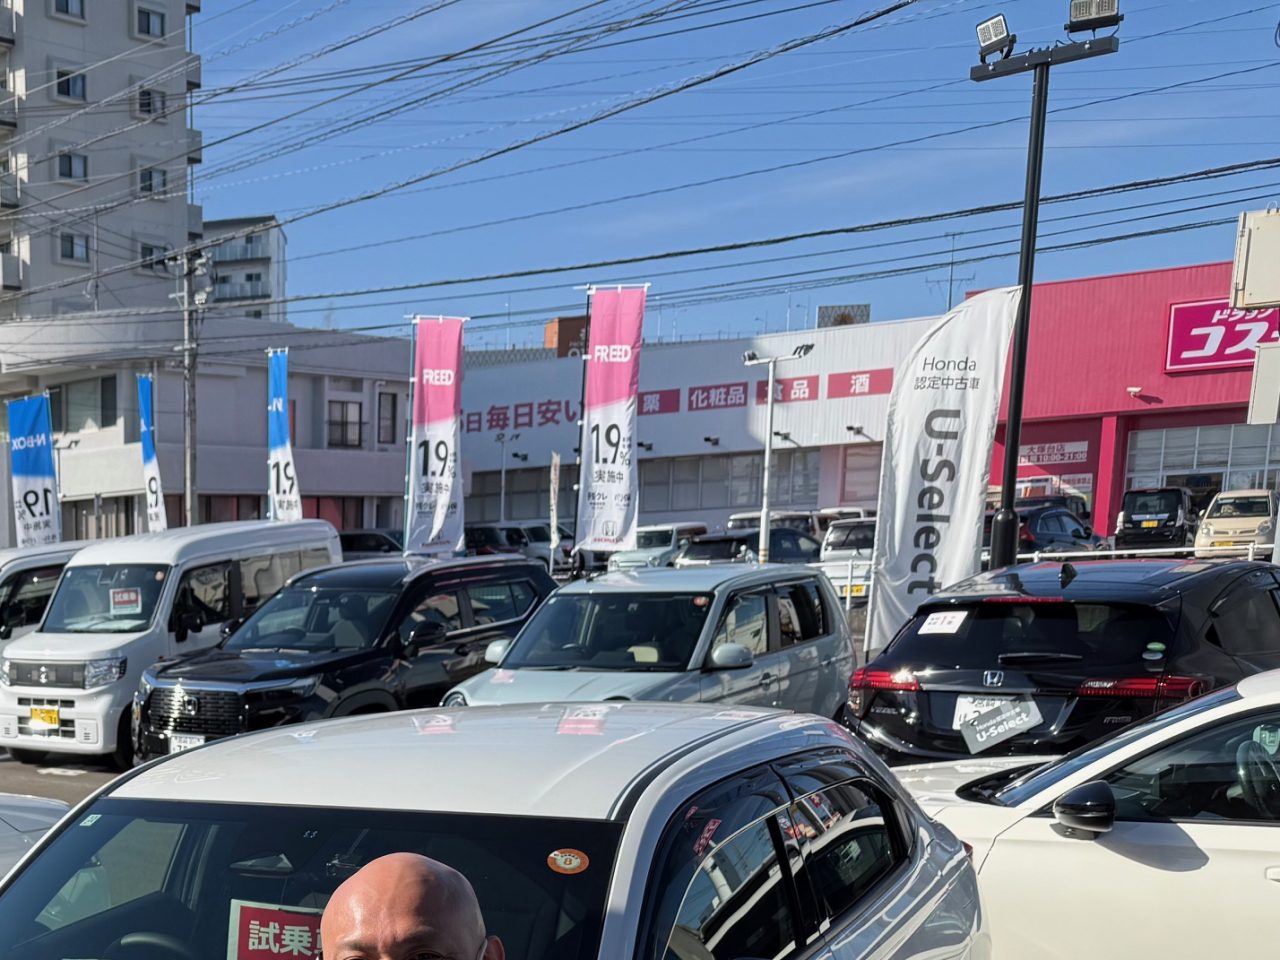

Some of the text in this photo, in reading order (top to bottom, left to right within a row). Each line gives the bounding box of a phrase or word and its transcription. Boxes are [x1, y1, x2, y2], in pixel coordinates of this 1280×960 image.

[1180, 321, 1280, 359] コス
[594, 344, 632, 362] FREED
[922, 356, 977, 372] Honda
[423, 369, 454, 386] FREED
[850, 374, 870, 394] 酒
[914, 376, 981, 391] 認定中古車
[691, 386, 745, 409] 化粧品
[907, 409, 961, 595] U-Select
[976, 712, 1029, 742] U-Select
[248, 920, 322, 956] 試乗
